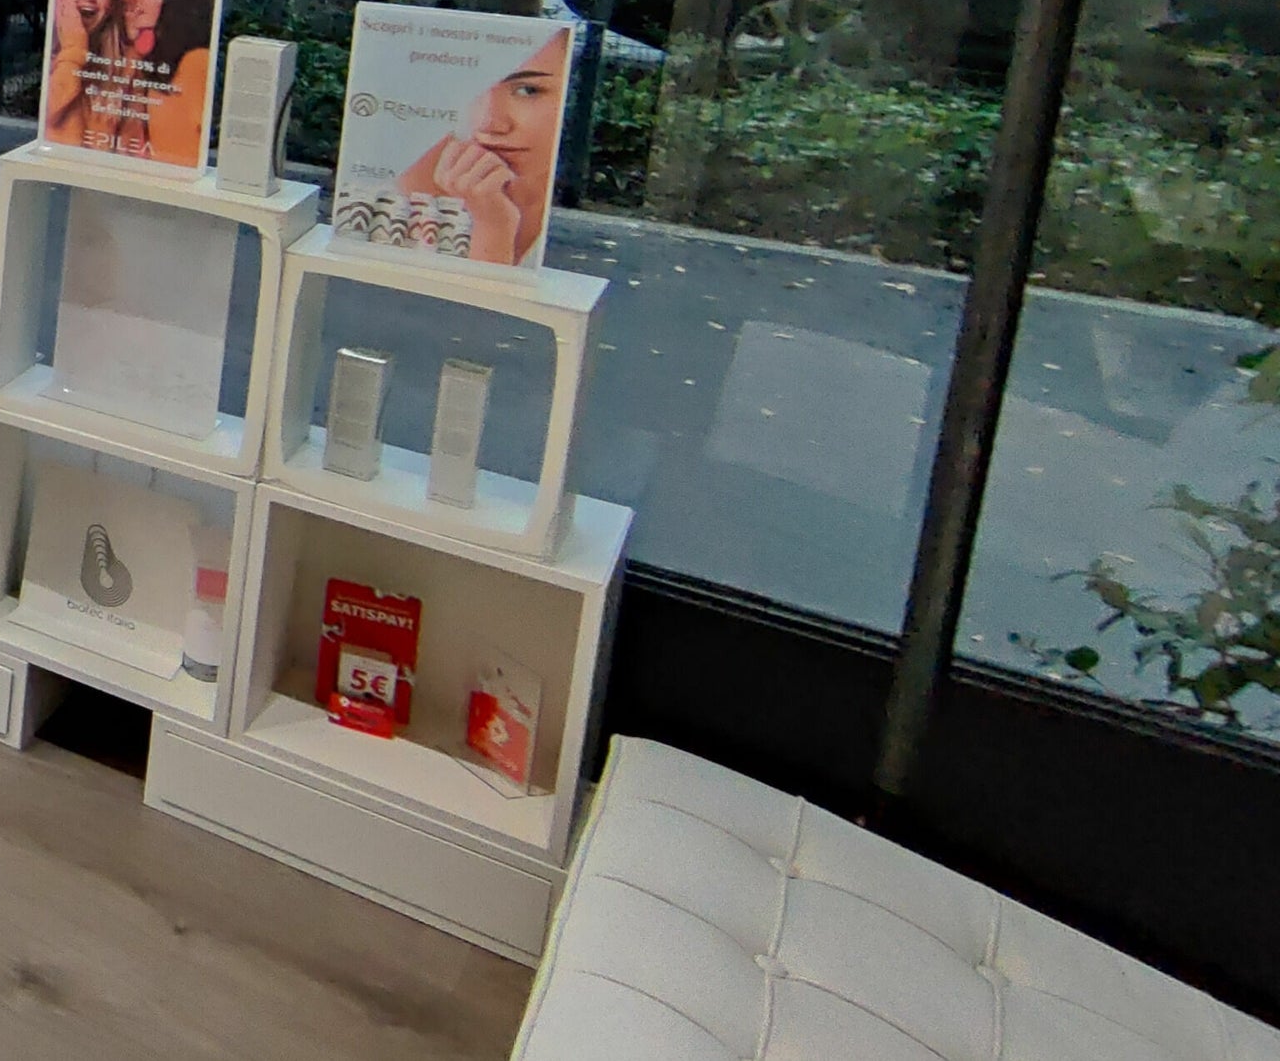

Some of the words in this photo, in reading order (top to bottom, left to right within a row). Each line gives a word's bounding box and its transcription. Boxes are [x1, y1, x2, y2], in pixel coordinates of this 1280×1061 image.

[362, 19, 411, 35] Scopri
[430, 26, 480, 41] nostri
[84, 52, 111, 66] Fino
[114, 57, 127, 68] al
[157, 62, 171, 75] di
[408, 50, 480, 69] prodotti
[112, 75, 130, 85] sui
[84, 83, 99, 96] di
[101, 87, 163, 106] epilazione
[382, 99, 460, 123] RENLIVE
[82, 128, 157, 157] EPILEA
[66, 599, 105, 621] biotec
[106, 614, 136, 632] italia
[349, 668, 389, 698] 5€
